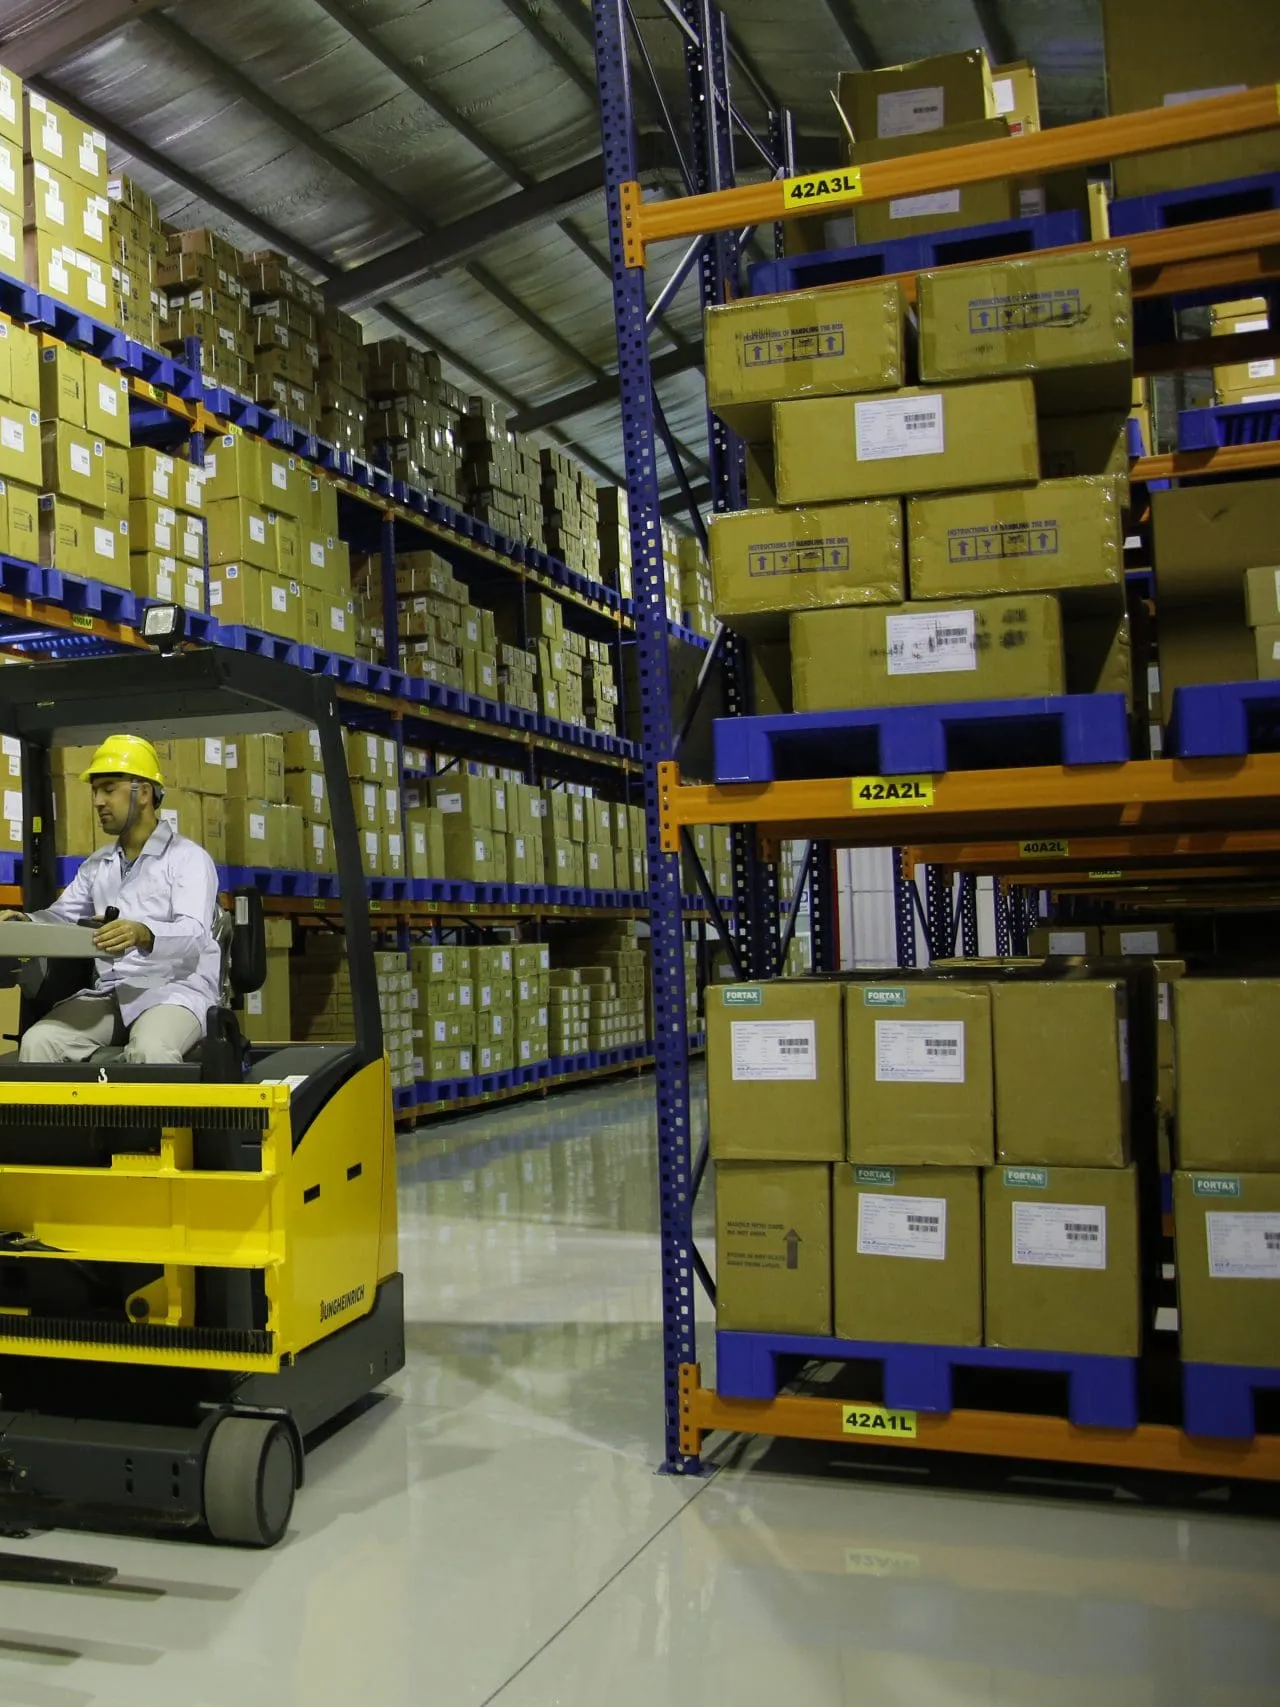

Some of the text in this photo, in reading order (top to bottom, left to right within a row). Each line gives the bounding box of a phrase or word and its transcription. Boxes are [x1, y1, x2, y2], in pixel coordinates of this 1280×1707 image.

[790, 177, 855, 199] 42A3L
[948, 526, 989, 536] INSTRUCTIONS
[748, 541, 786, 551] INSTRUCTIONS
[860, 783, 923, 801] 42A2L
[1023, 842, 1064, 854] 40A2L
[727, 991, 759, 1000] FORTAX
[868, 992, 901, 1000] FORTAX
[858, 1170, 891, 1179] FORTAX
[1008, 1171, 1044, 1181] FORTAX
[1197, 1181, 1236, 1190] FORTAX
[320, 1284, 365, 1322] JUNGHEINRICH
[845, 1412, 912, 1432] 42A1L
